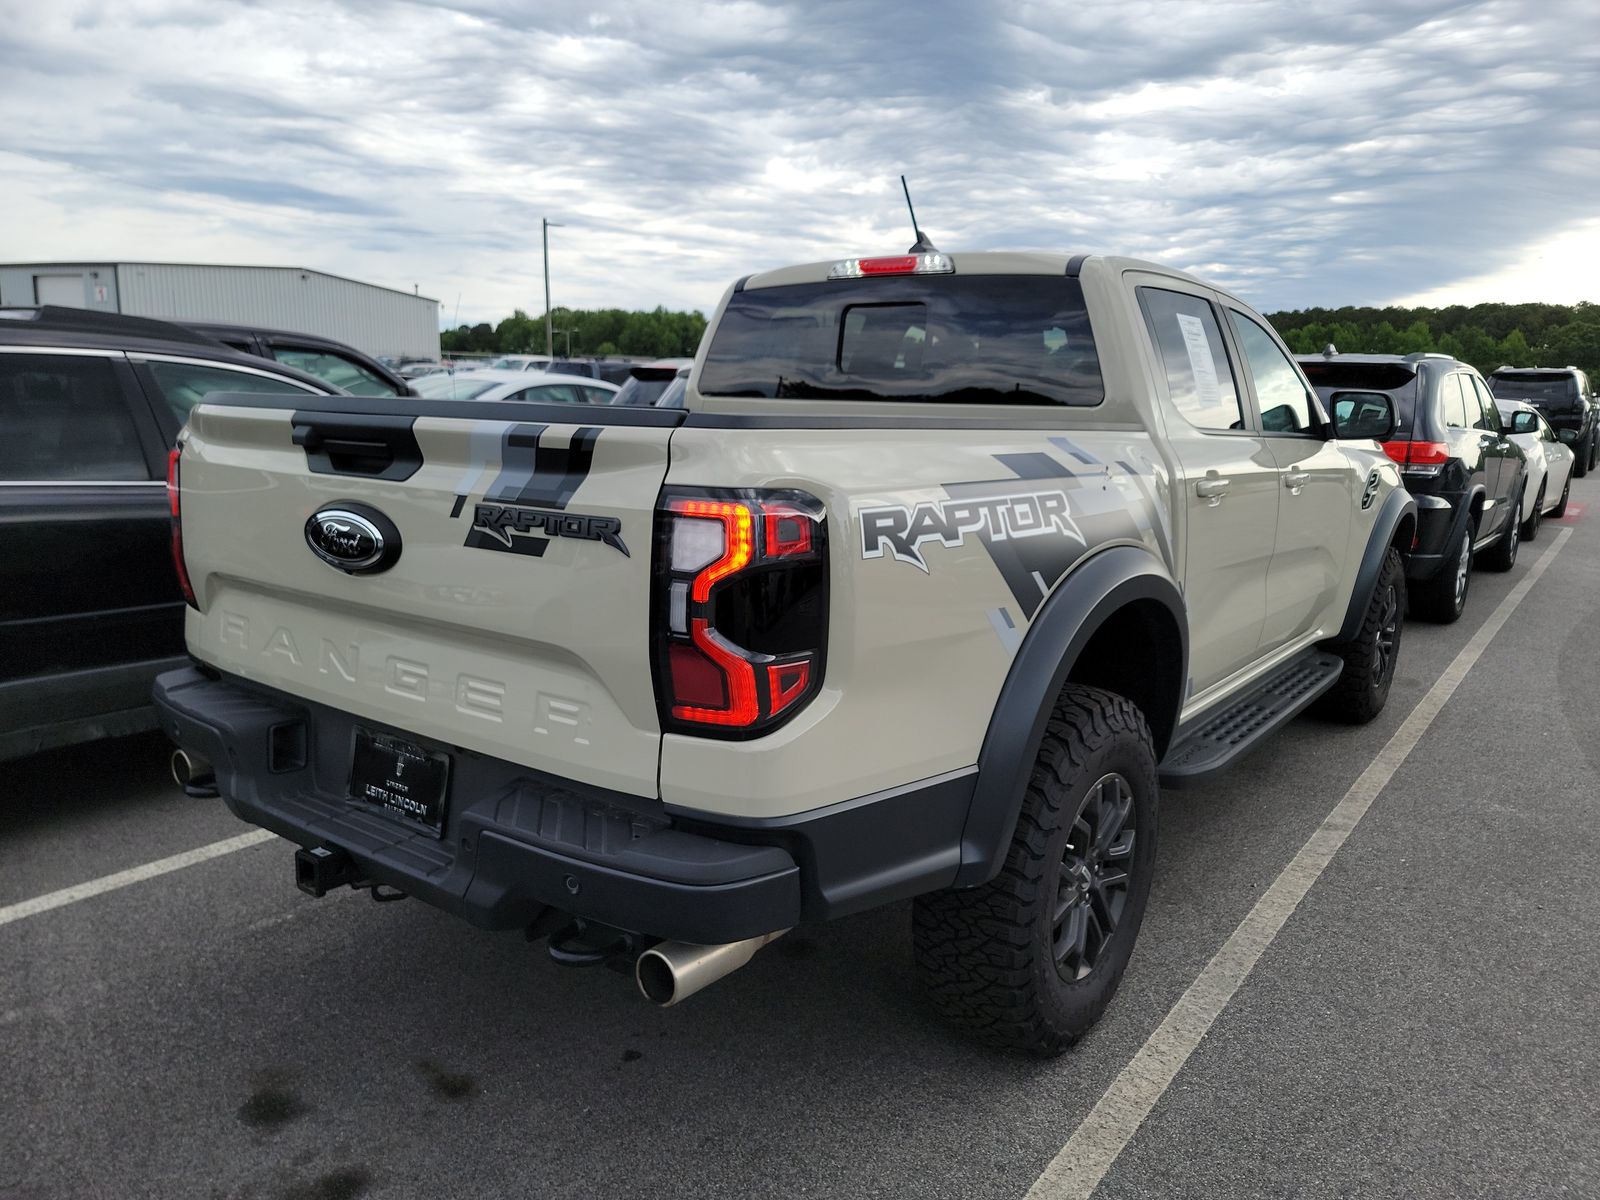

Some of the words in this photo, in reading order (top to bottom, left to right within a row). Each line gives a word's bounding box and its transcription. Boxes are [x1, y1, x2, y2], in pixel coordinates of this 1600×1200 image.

[321, 521, 361, 548] Ford
[475, 503, 631, 558] RAPTOR
[858, 490, 1088, 575] RAPTOR
[219, 610, 592, 745] RANGER
[365, 784, 389, 802] LEITH
[389, 793, 428, 816] LINCOLN
